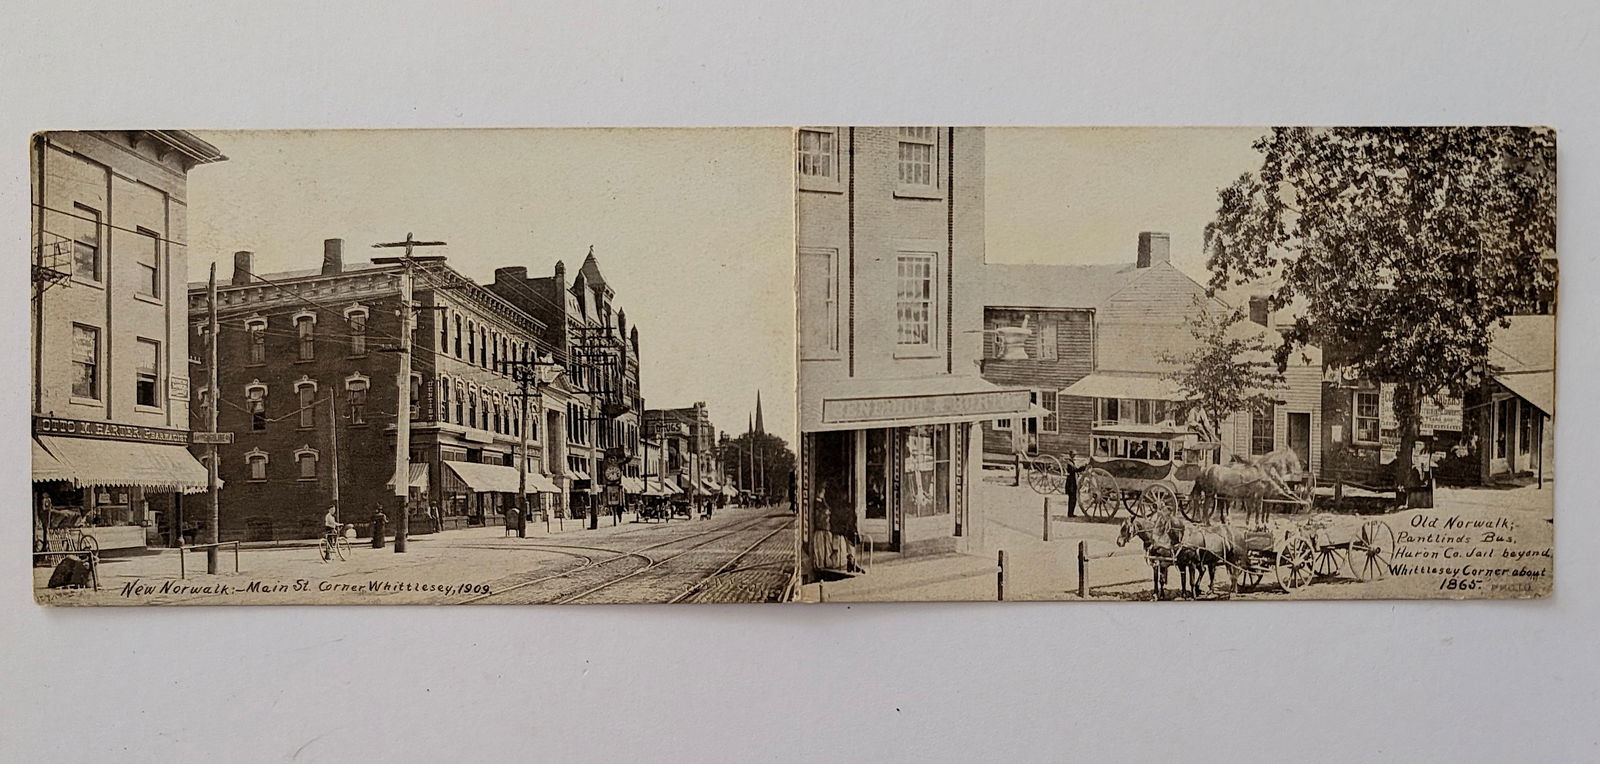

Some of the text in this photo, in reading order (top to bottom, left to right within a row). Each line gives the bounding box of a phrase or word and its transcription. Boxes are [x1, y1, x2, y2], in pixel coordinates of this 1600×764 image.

[42, 418, 76, 433] OTTO
[80, 421, 93, 435] M.
[144, 428, 189, 443] PHARMACIST
[1410, 514, 1438, 529] Old
[1397, 531, 1471, 544] Pantlinds
[1394, 546, 1439, 560] Huron
[1443, 547, 1462, 559] Co.
[1466, 547, 1494, 559] Jail
[1388, 564, 1546, 577] Whittlesey Corner about
[120, 578, 156, 598] New
[292, 578, 312, 592] St.
[318, 580, 366, 593] Corner
